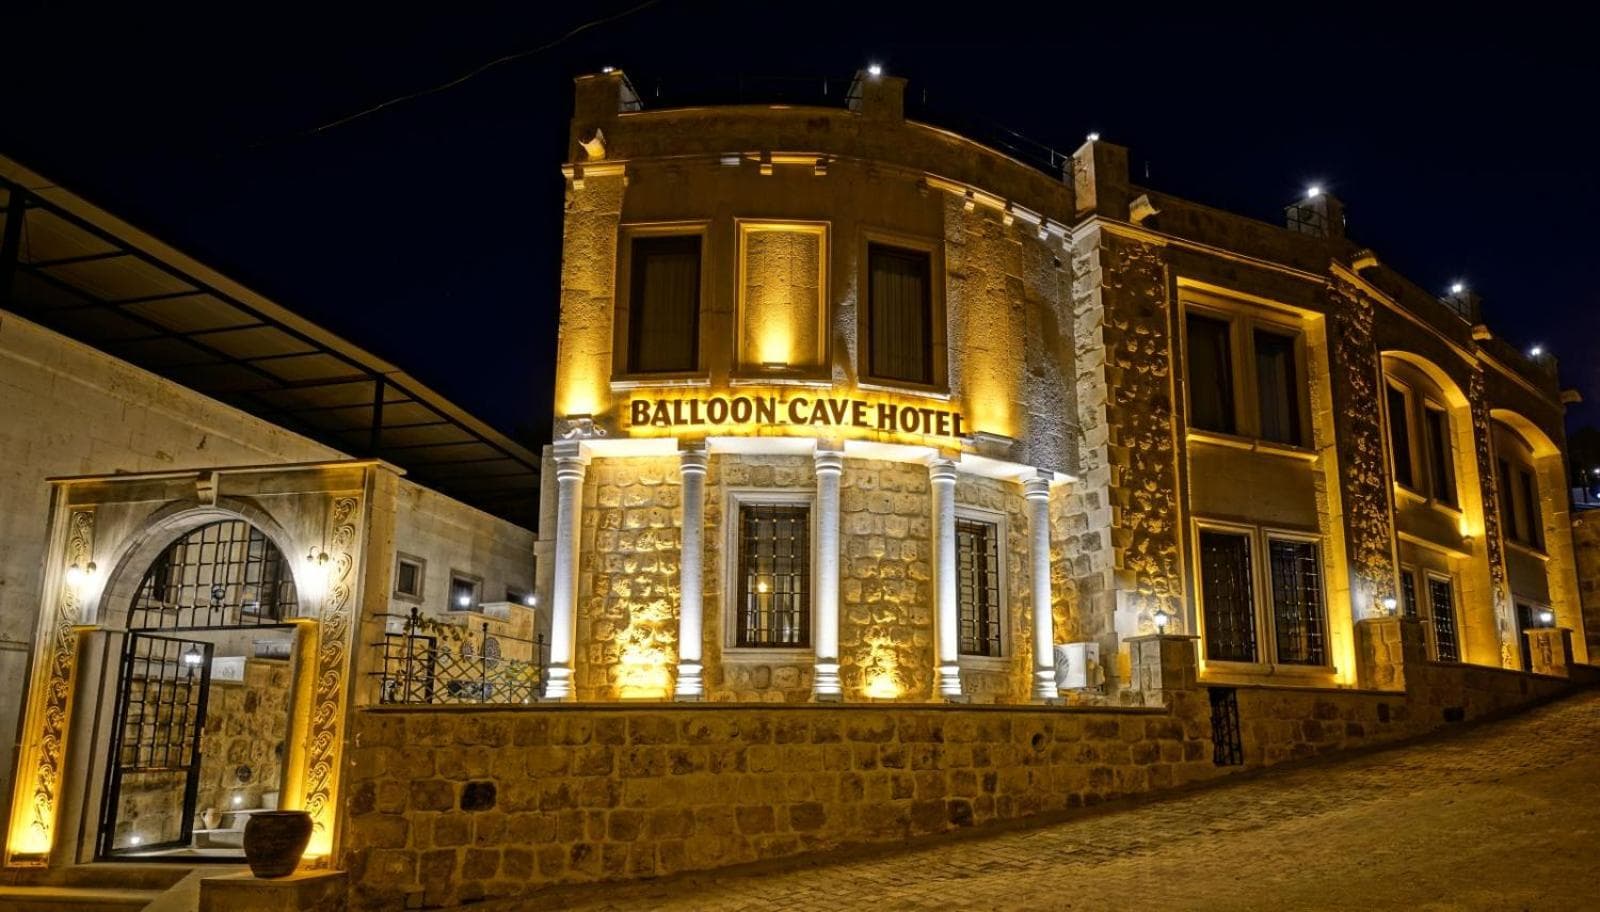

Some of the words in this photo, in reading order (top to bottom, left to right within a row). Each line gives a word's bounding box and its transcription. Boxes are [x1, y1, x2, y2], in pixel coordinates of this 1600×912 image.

[631, 397, 776, 427] BALLOON
[788, 397, 867, 426] CAVE
[878, 403, 966, 437] HOTEL
